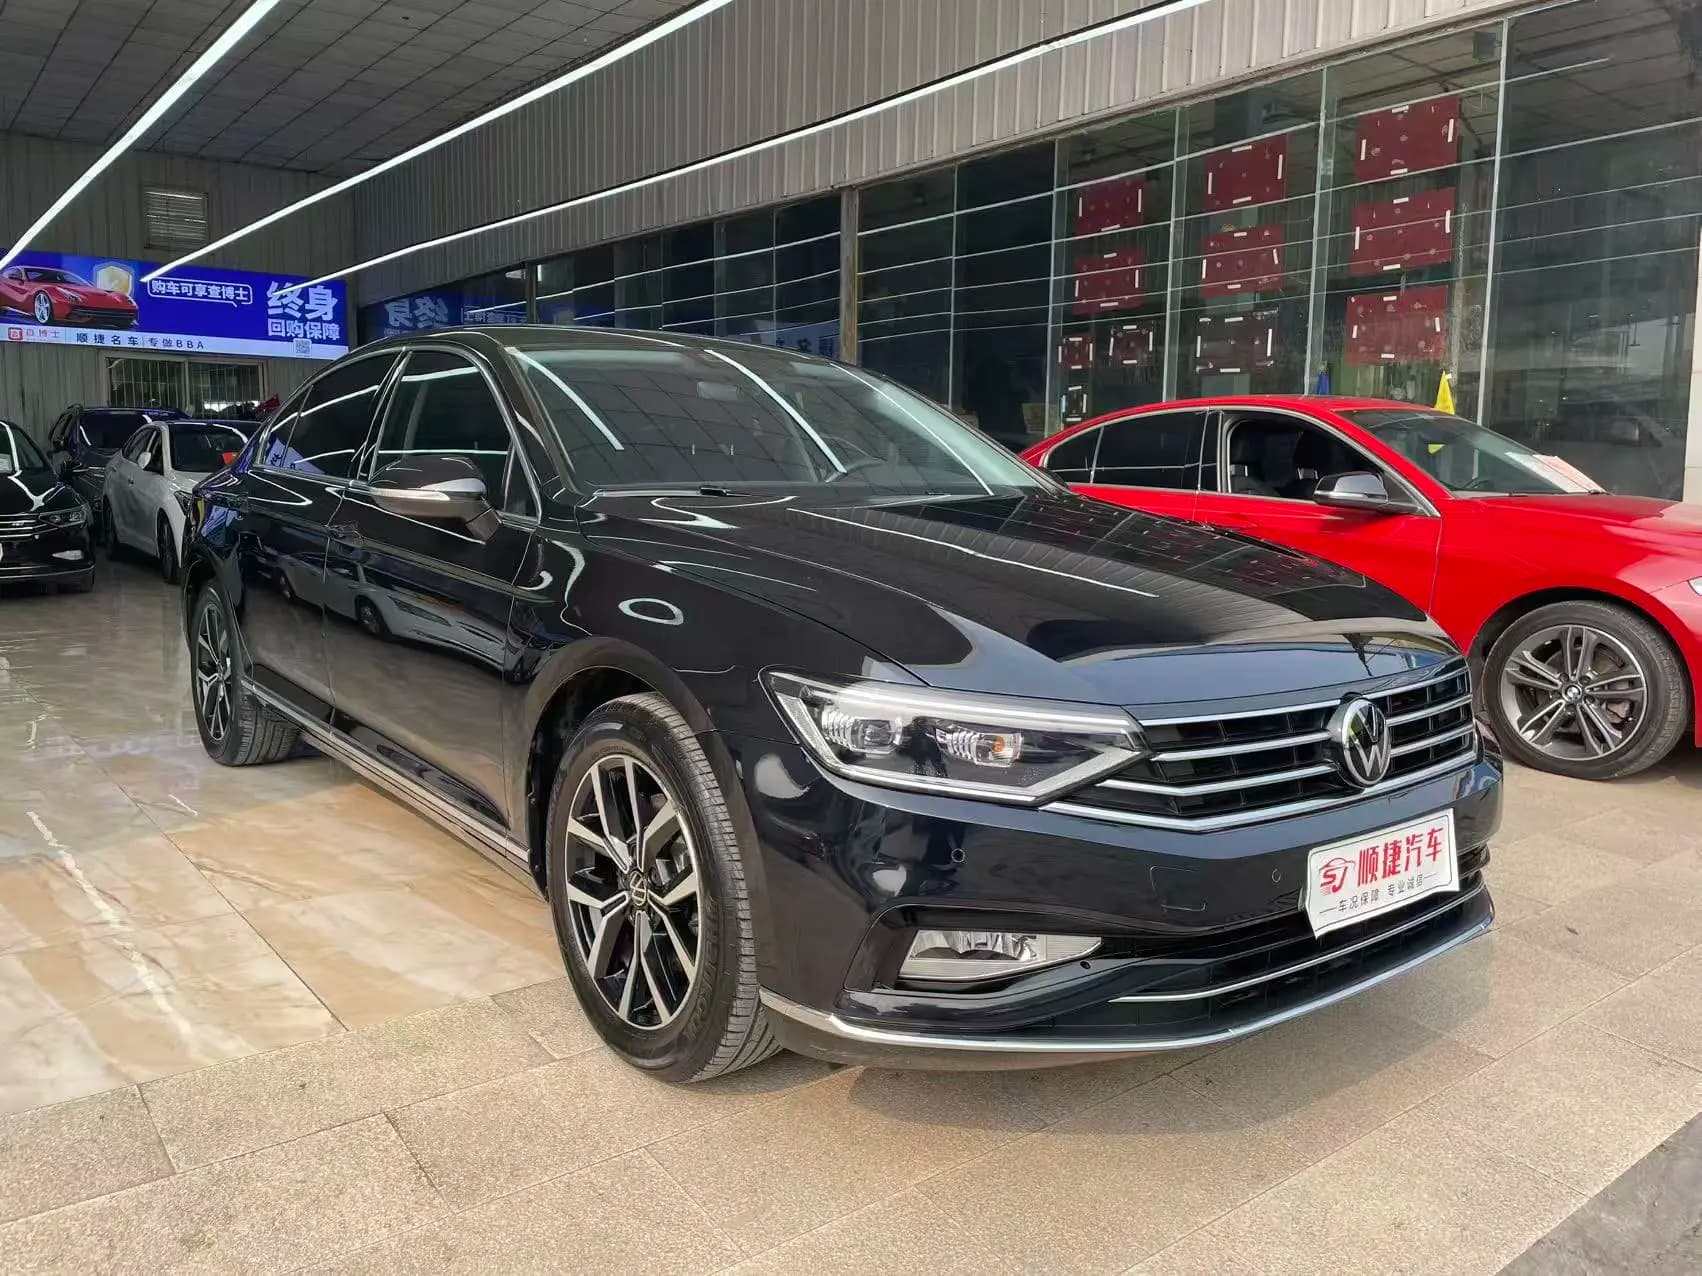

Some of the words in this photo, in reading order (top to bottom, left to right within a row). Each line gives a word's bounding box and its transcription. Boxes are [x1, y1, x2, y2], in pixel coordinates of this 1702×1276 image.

[151, 279, 249, 301] 购车可享查博士
[266, 281, 338, 321] 终身
[76, 332, 139, 347] 顺捷名车
[267, 318, 340, 341] 回购保障
[1357, 827, 1444, 887] 顺捷汽车
